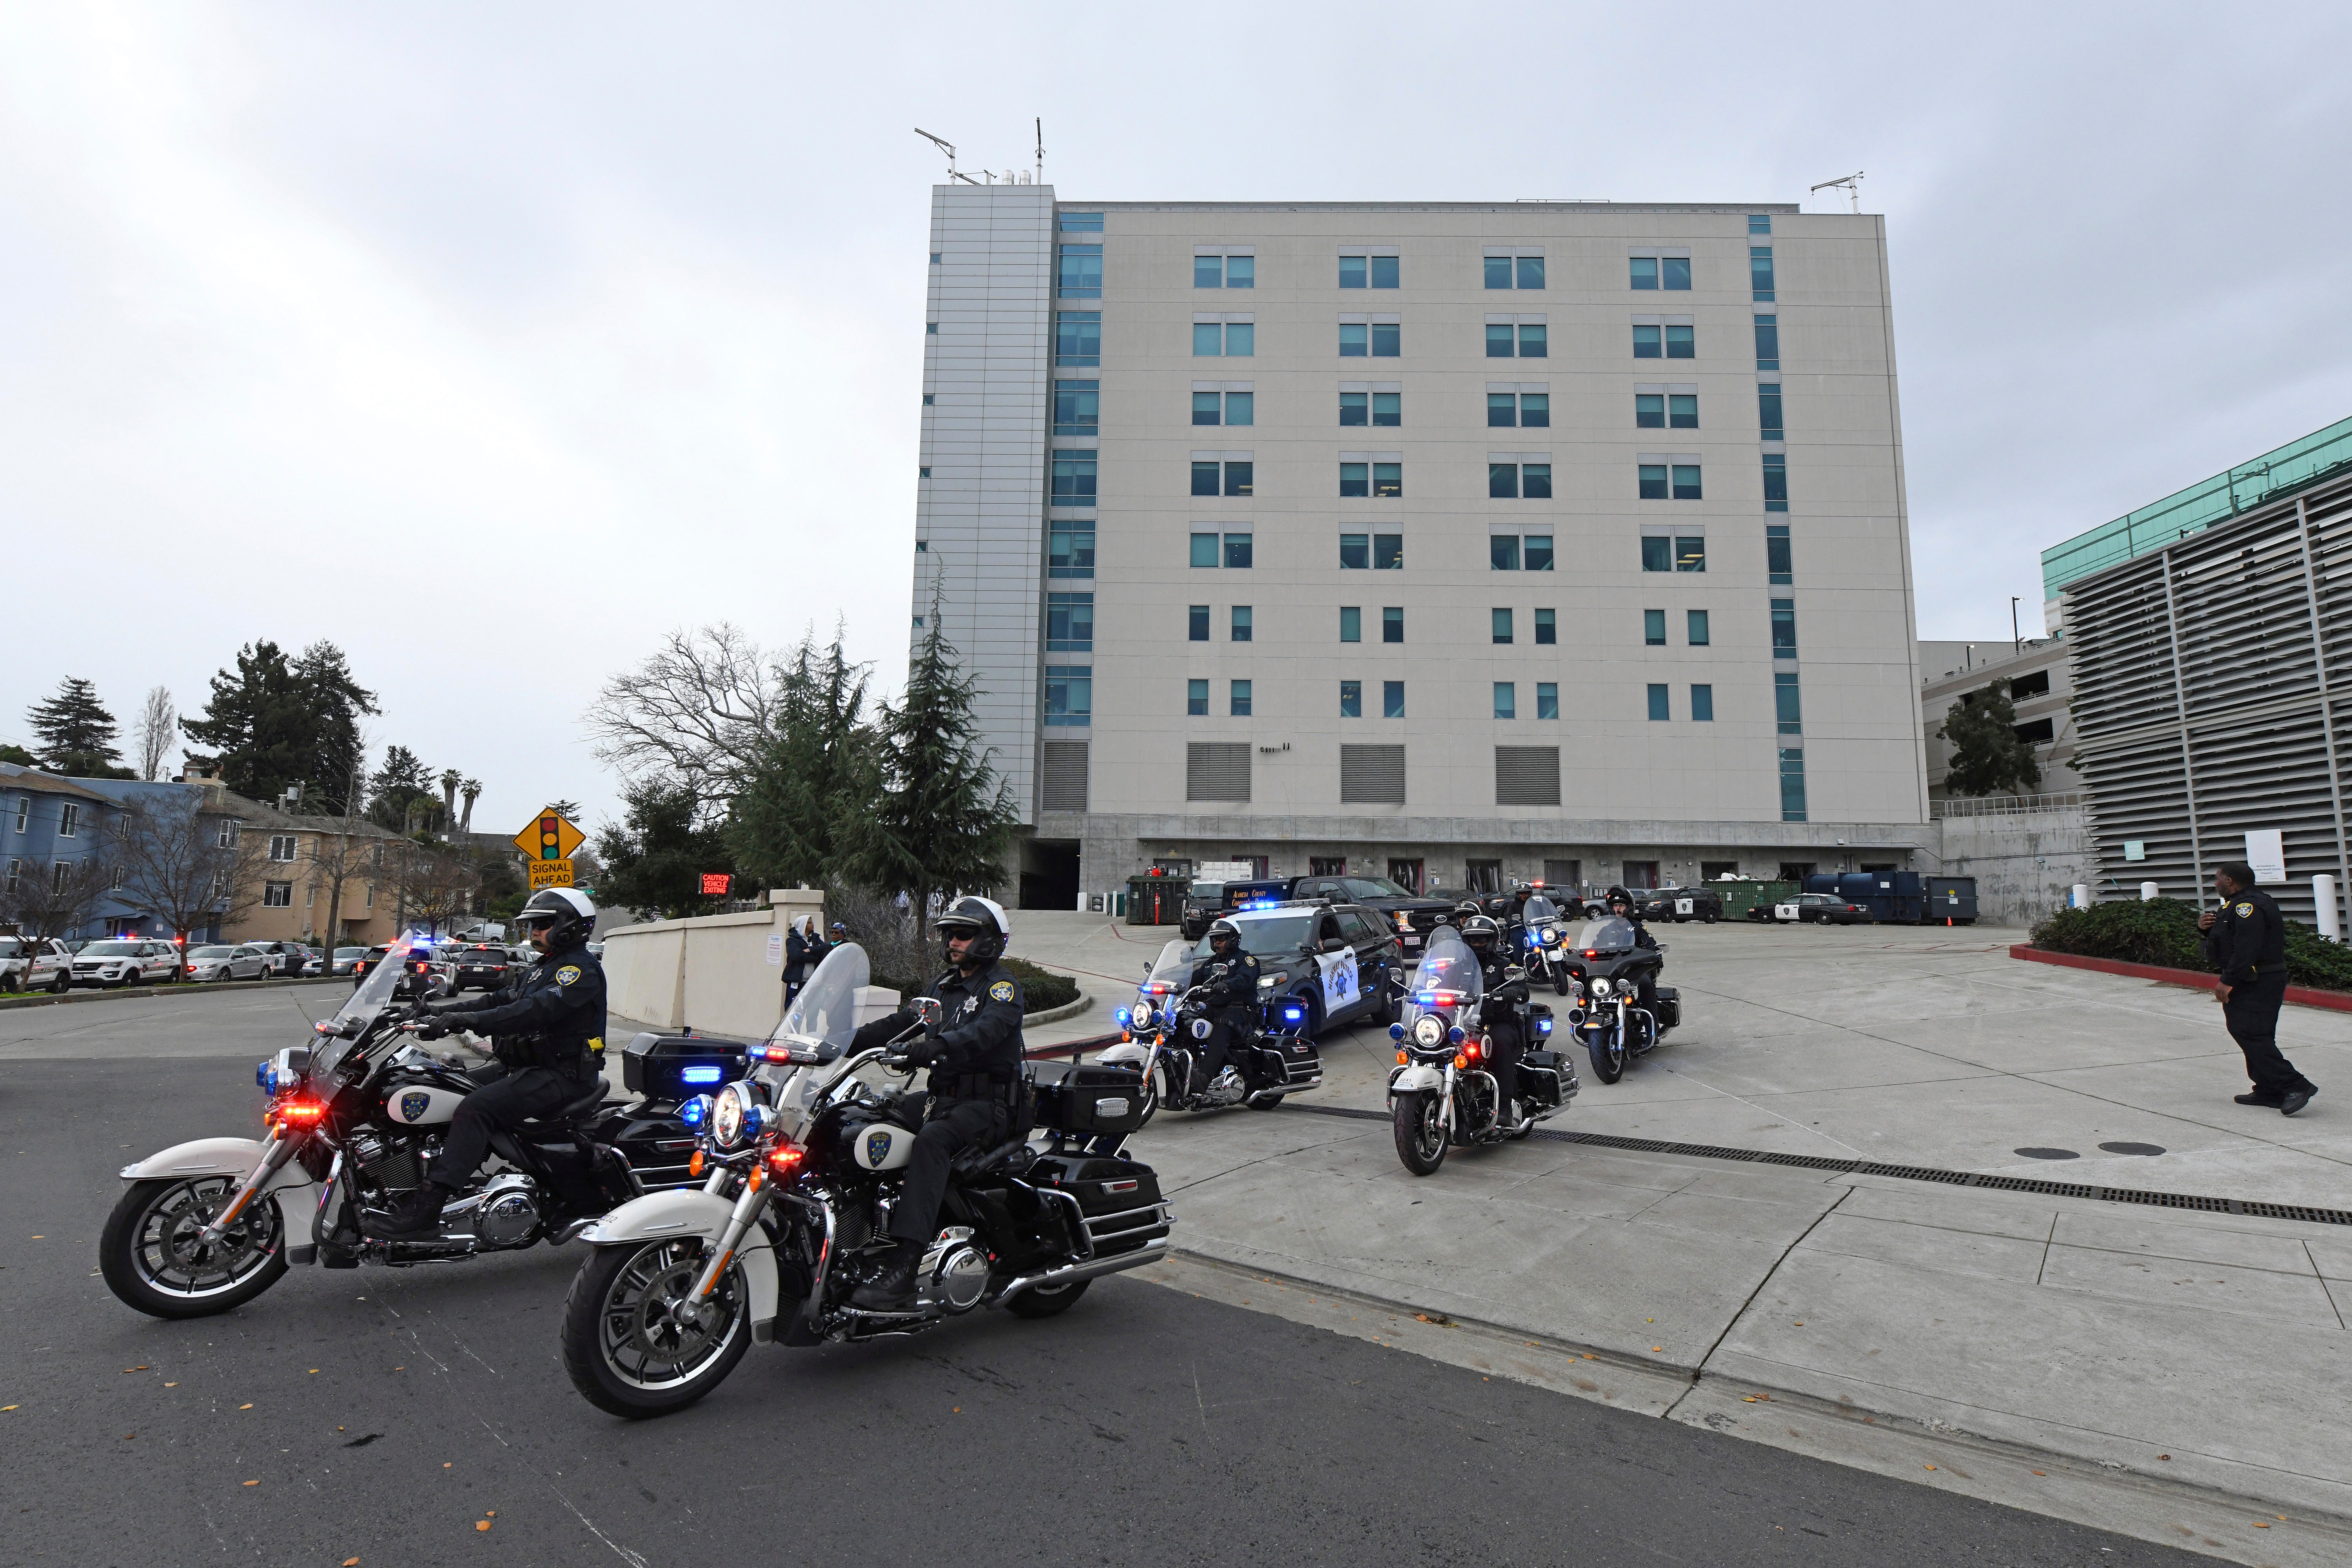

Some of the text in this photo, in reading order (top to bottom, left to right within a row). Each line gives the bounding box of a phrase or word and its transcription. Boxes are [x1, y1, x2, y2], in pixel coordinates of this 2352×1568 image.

[532, 863, 570, 873] SIGNAL
[534, 875, 570, 885] AHEAD
[1328, 960, 1353, 990] HIGHWAY PATROL
